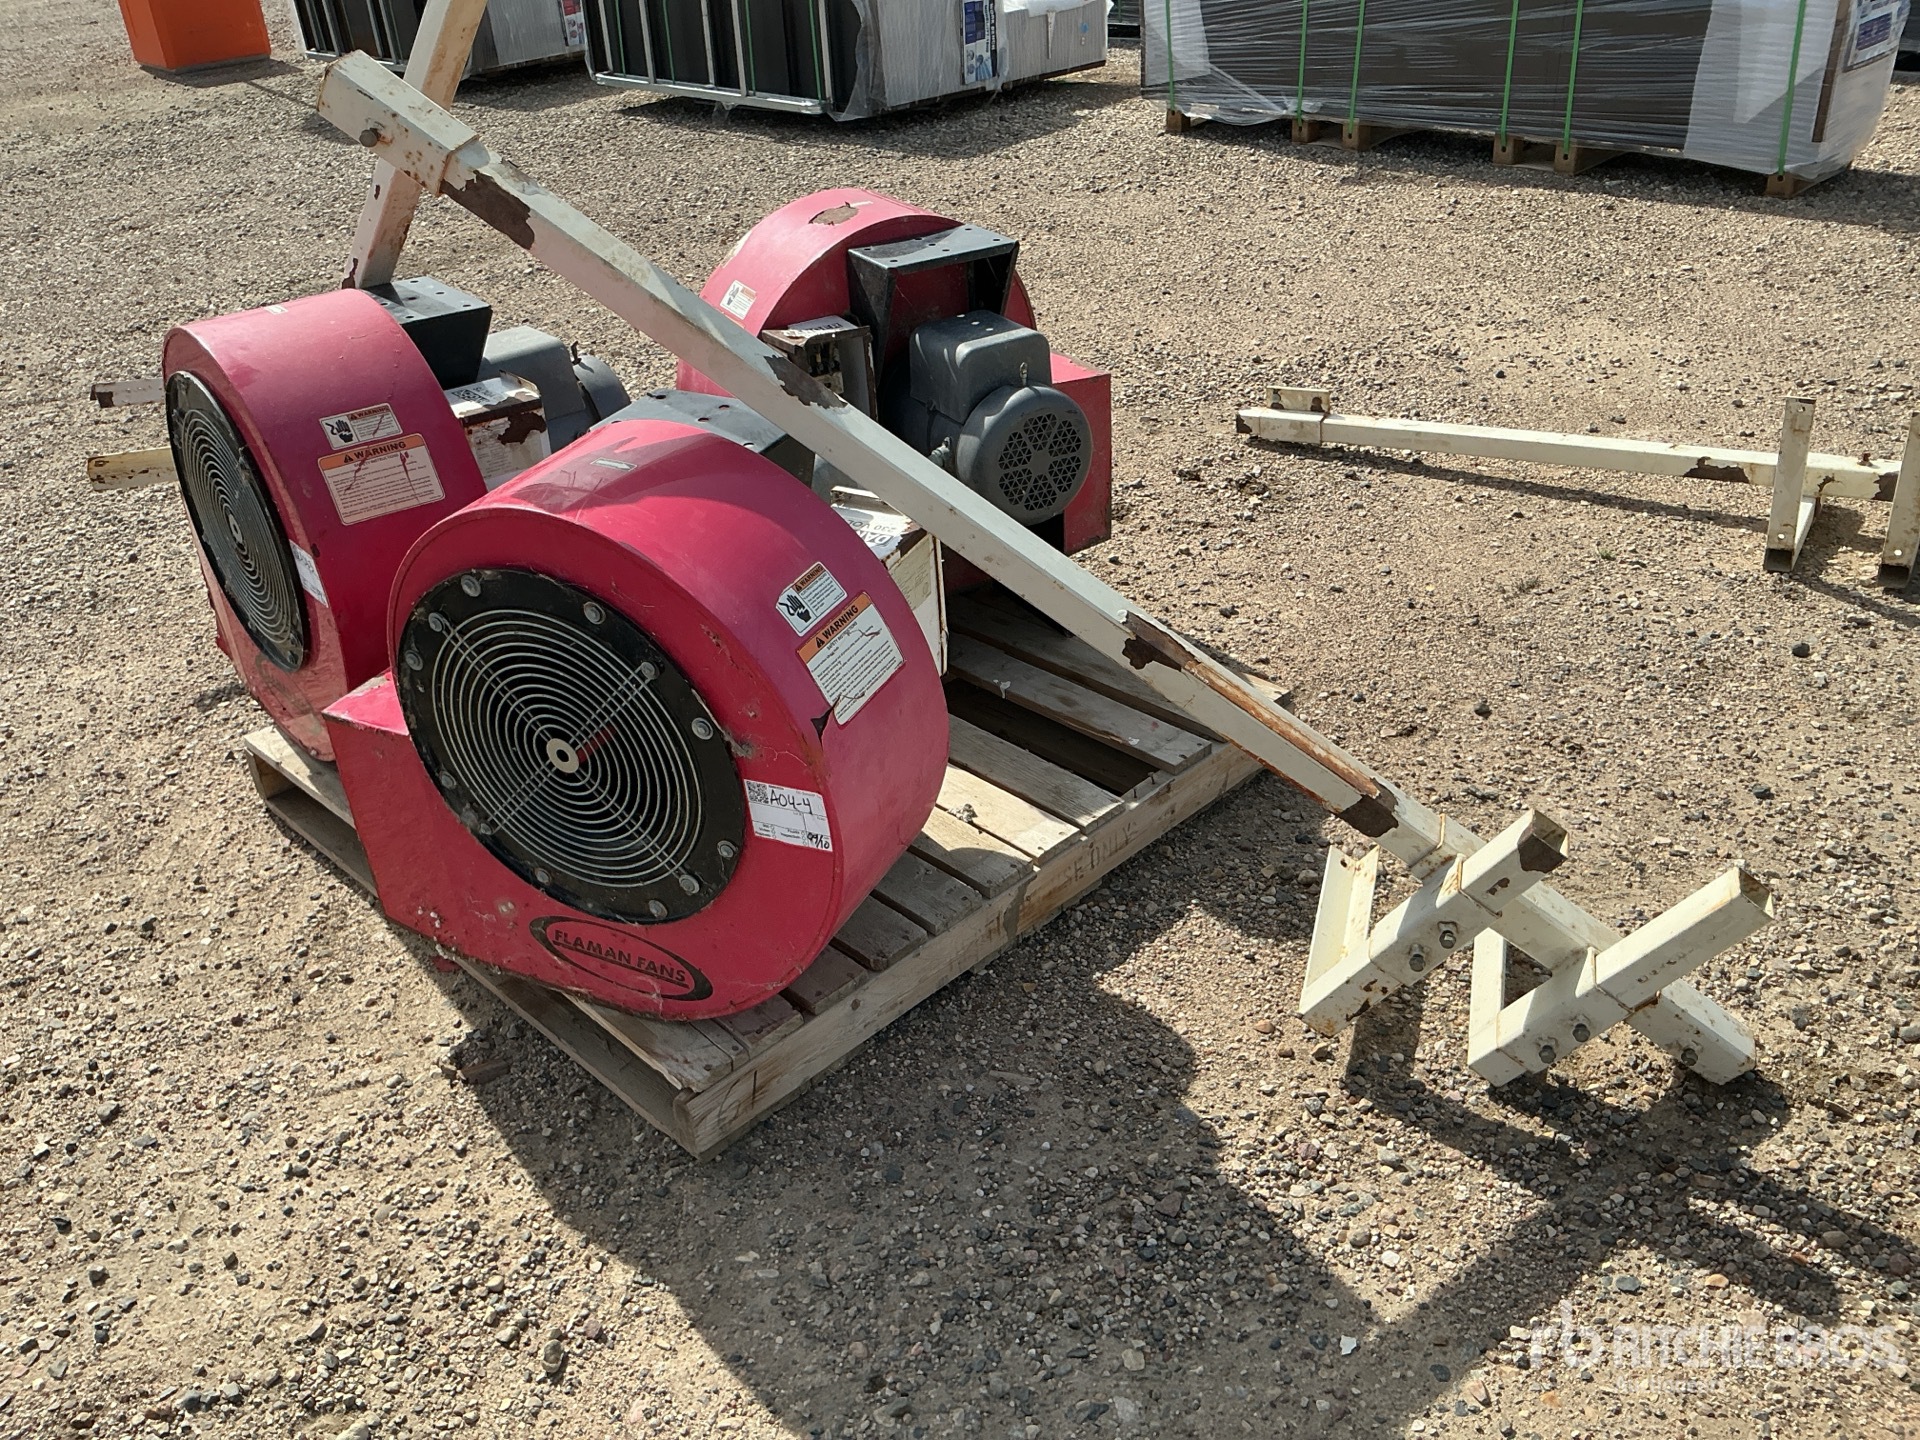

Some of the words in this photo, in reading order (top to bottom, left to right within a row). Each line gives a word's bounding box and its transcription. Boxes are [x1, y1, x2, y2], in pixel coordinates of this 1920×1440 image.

[358, 405, 390, 418] WARNING
[354, 441, 407, 460] WARNING
[800, 565, 824, 587] WARNING
[822, 604, 859, 640] WARNING
[770, 788, 813, 815] A04-4
[554, 929, 632, 964] FLAMAN
[636, 956, 686, 983] FANS
